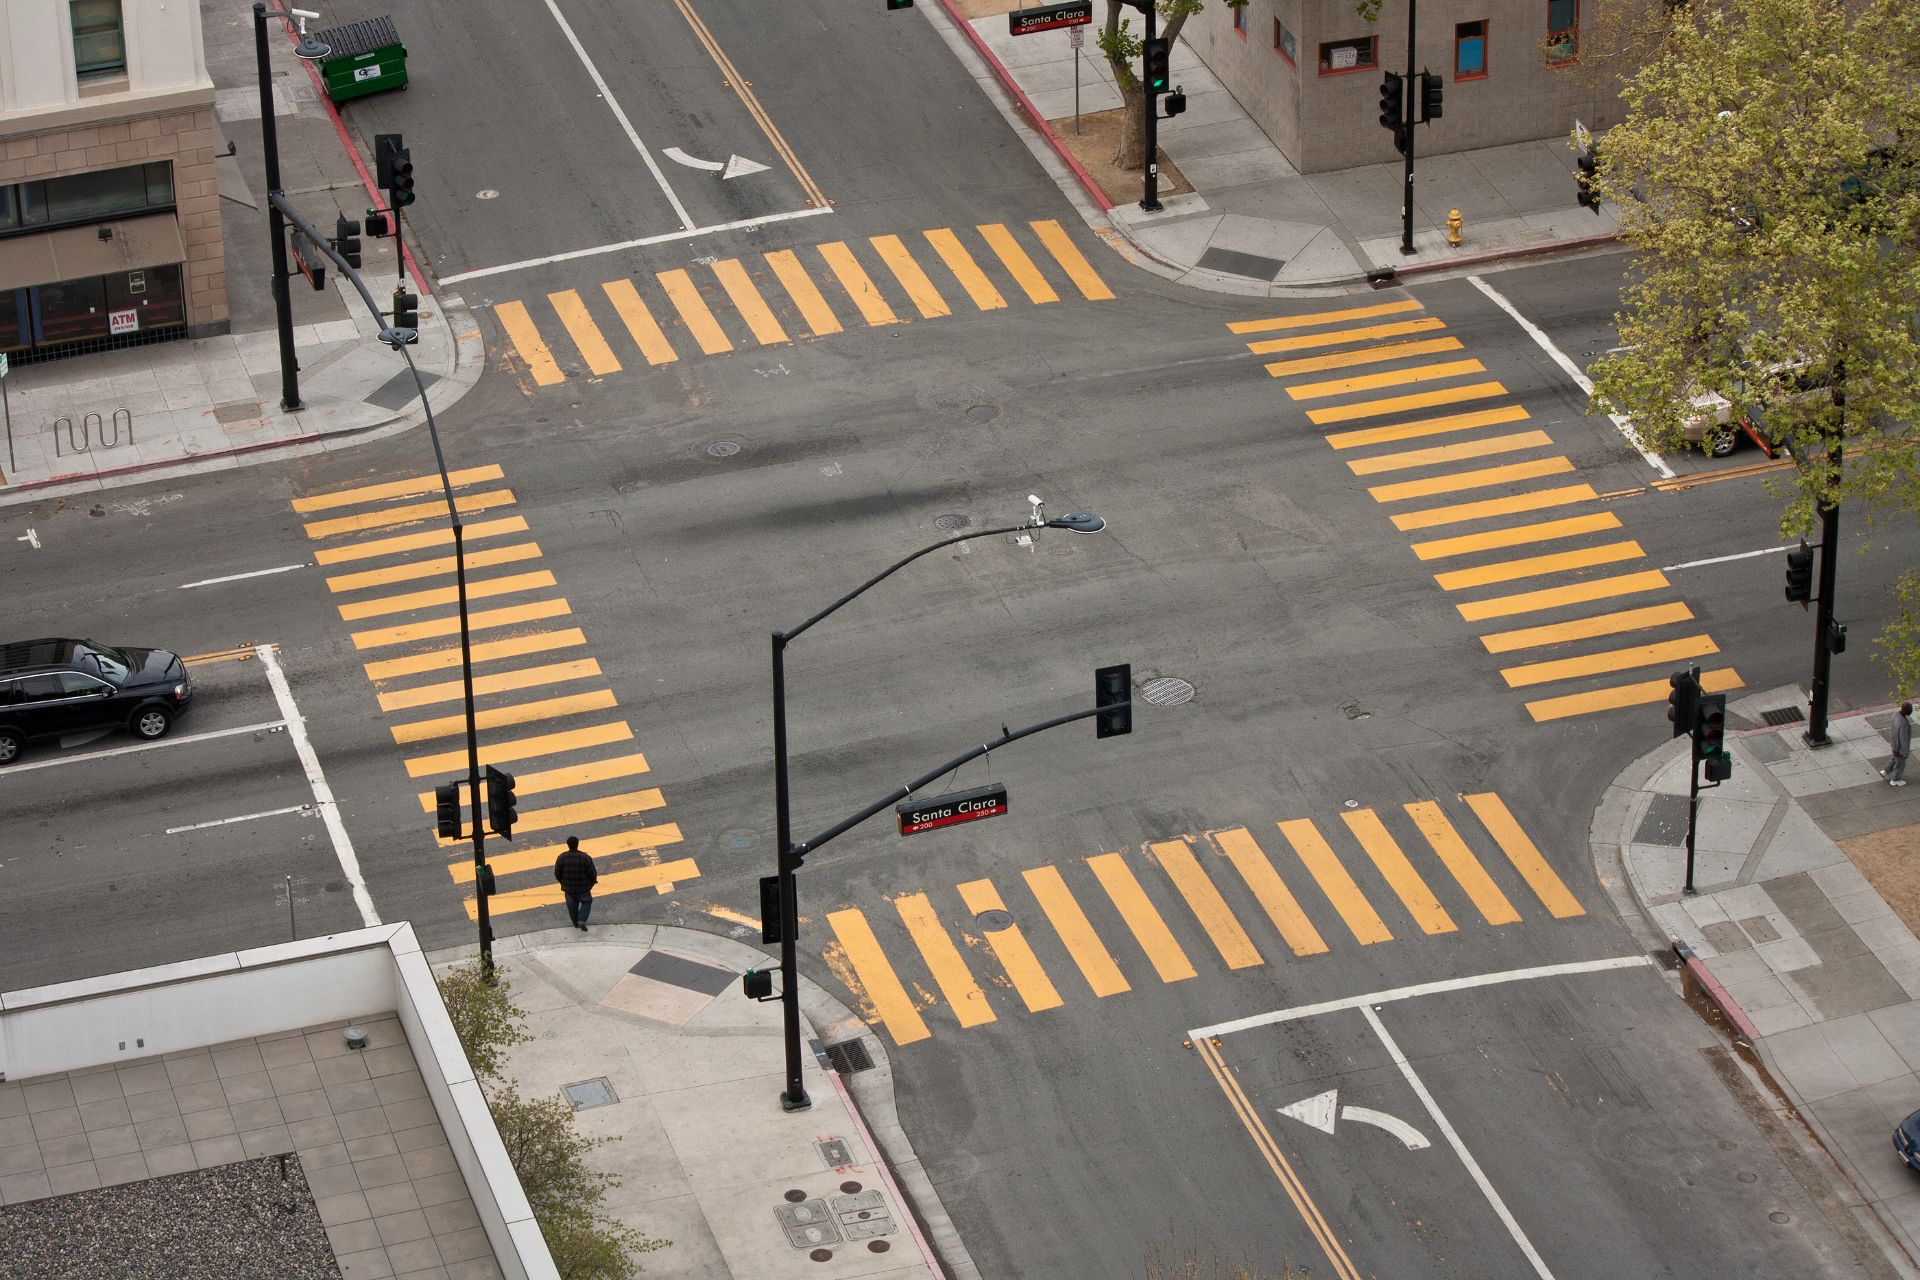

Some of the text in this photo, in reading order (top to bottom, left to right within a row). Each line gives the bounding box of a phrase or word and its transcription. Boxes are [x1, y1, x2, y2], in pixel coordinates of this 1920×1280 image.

[1021, 10, 1085, 27] Santa Clara
[112, 313, 135, 325] ATM
[912, 799, 996, 824] Santa Clara
[919, 822, 933, 830] 200
